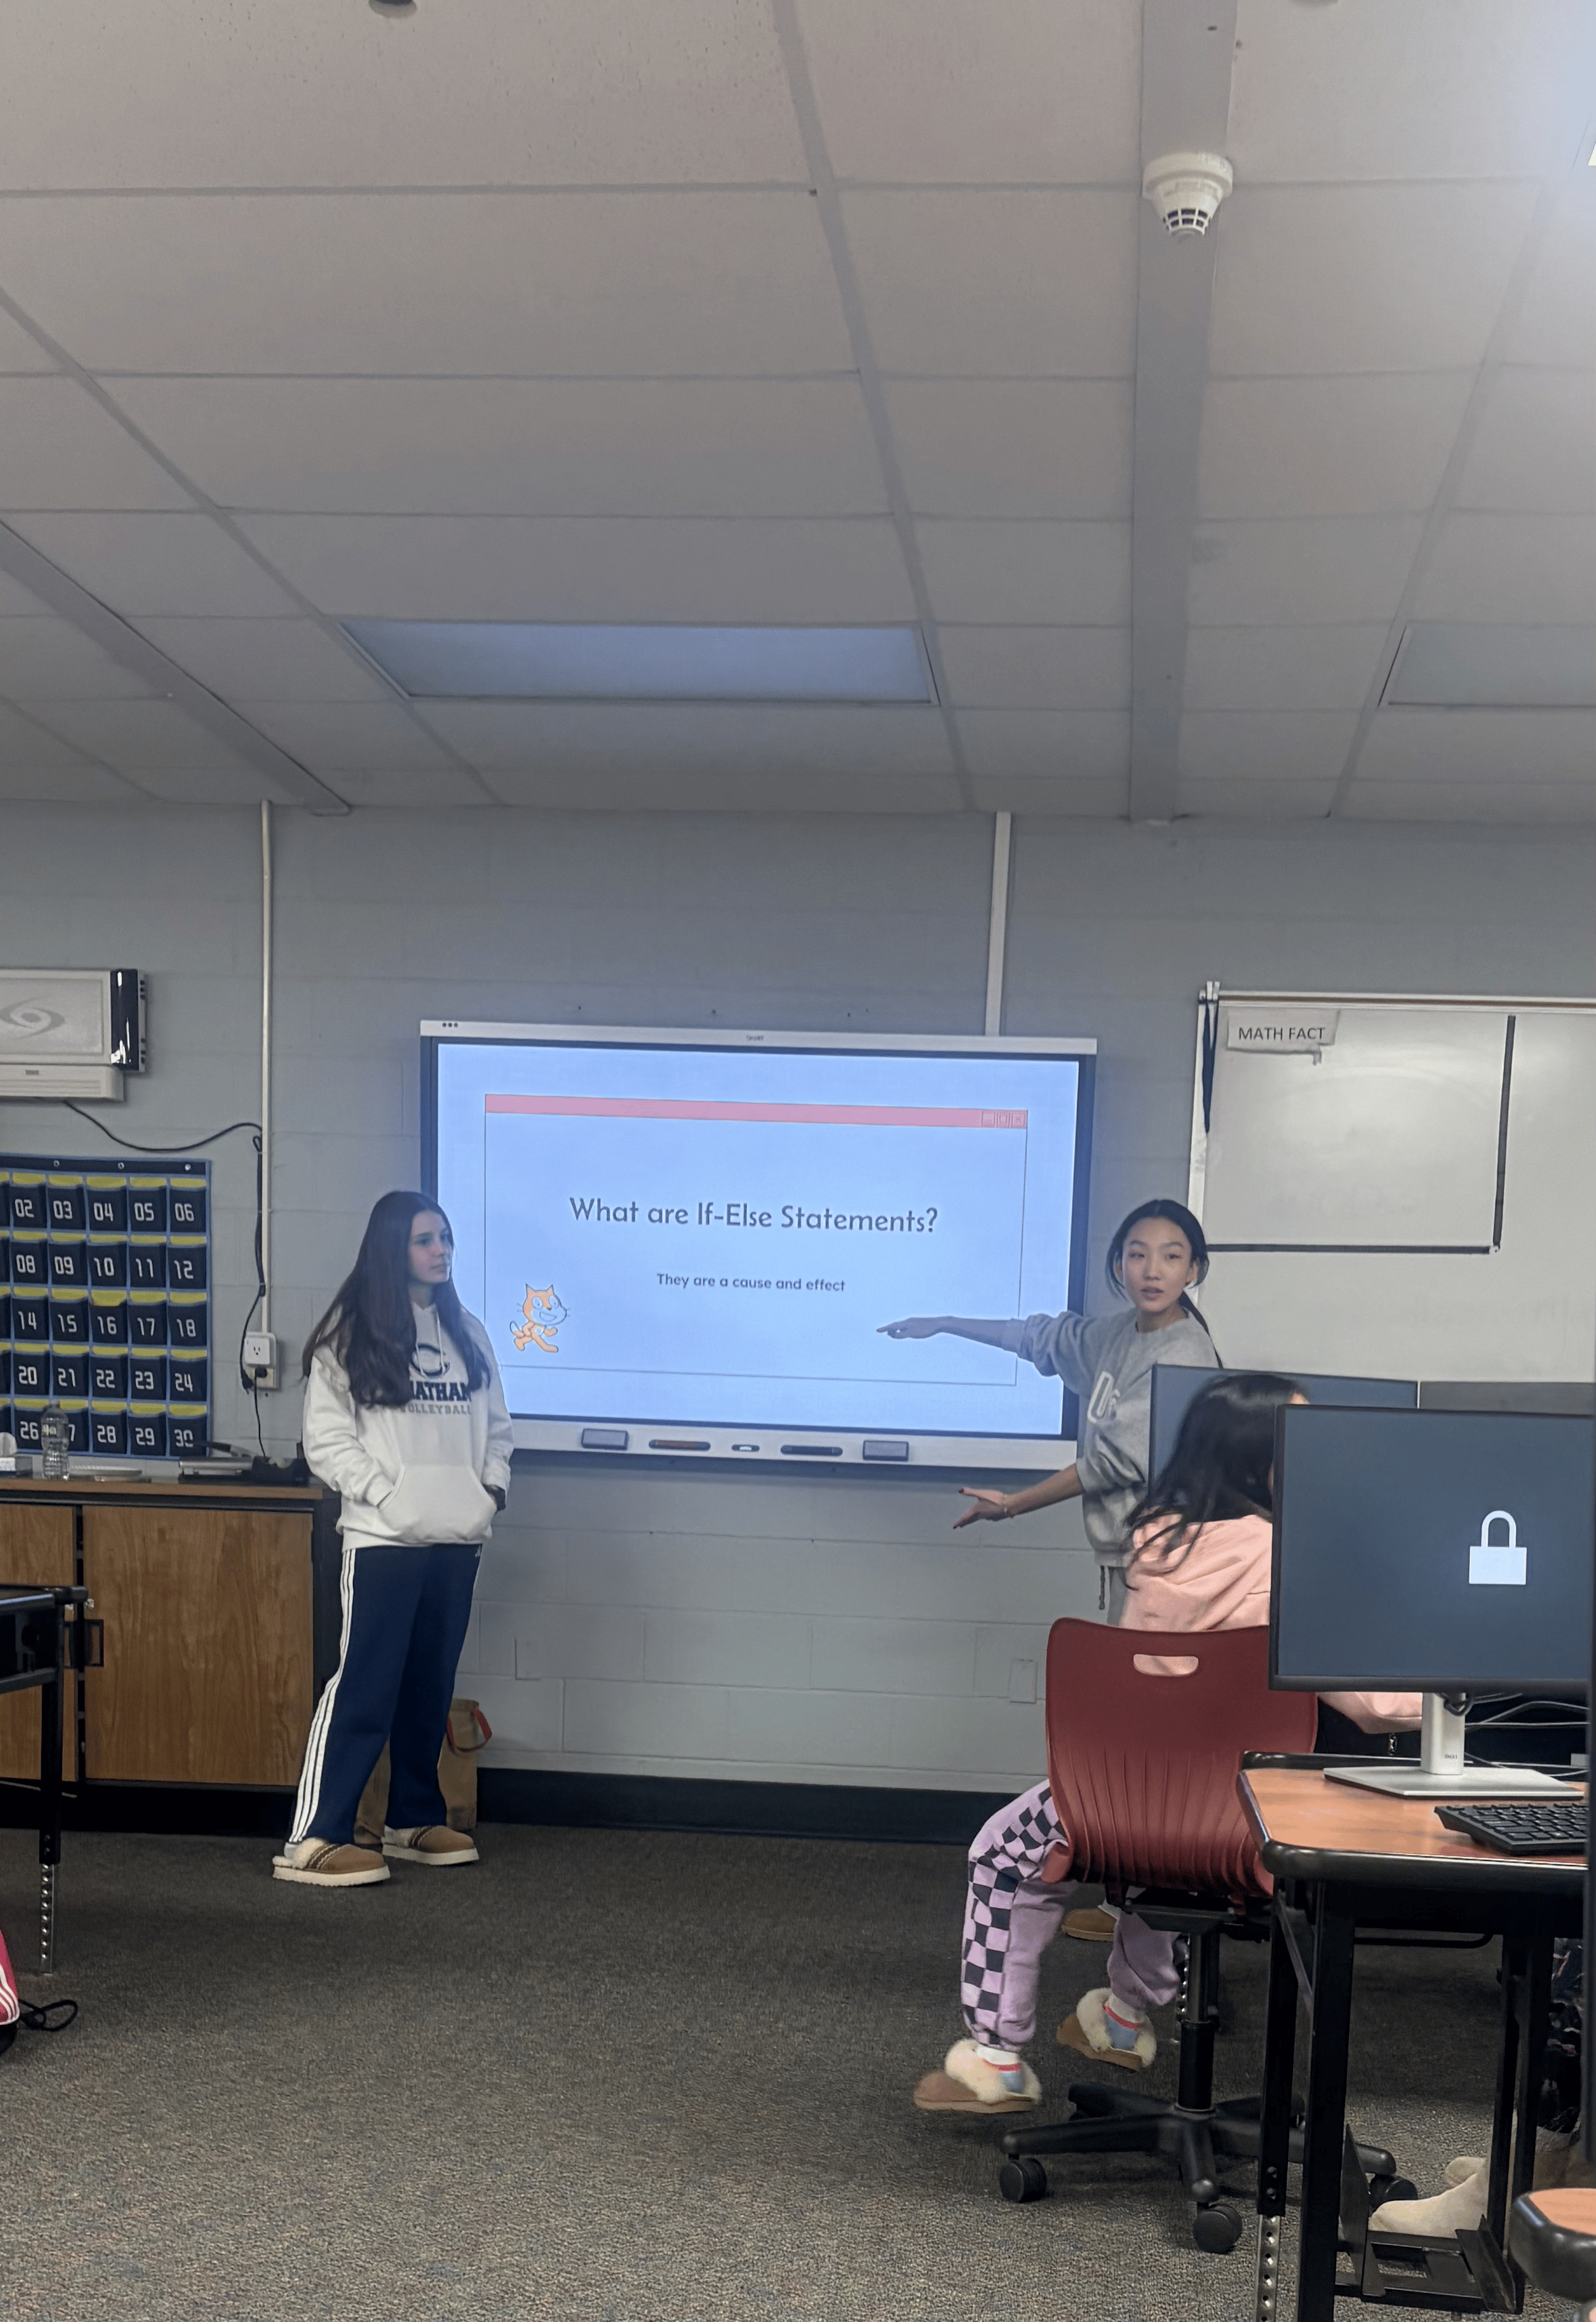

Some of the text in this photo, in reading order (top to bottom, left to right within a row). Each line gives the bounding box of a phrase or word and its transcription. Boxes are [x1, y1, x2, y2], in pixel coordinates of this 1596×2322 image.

[1239, 1028, 1325, 1040] MATH FACT
[15, 1199, 194, 1221] 02 03 04 05 06
[570, 1198, 937, 1232] What are If-Else Statements?
[17, 1255, 193, 1279] 08 09 10 11 12
[657, 1274, 689, 1288] They
[694, 1278, 715, 1286] are
[733, 1279, 771, 1288] cause
[776, 1279, 801, 1289] and
[806, 1279, 844, 1290] effect
[18, 1311, 196, 1337] 14 15 16 17 18
[19, 1366, 193, 1392] 20 21 22 23 24
[20, 1421, 39, 1439] 26
[98, 1426, 116, 1442] 28
[135, 1428, 154, 1445] 29
[175, 1429, 193, 1447] 30
